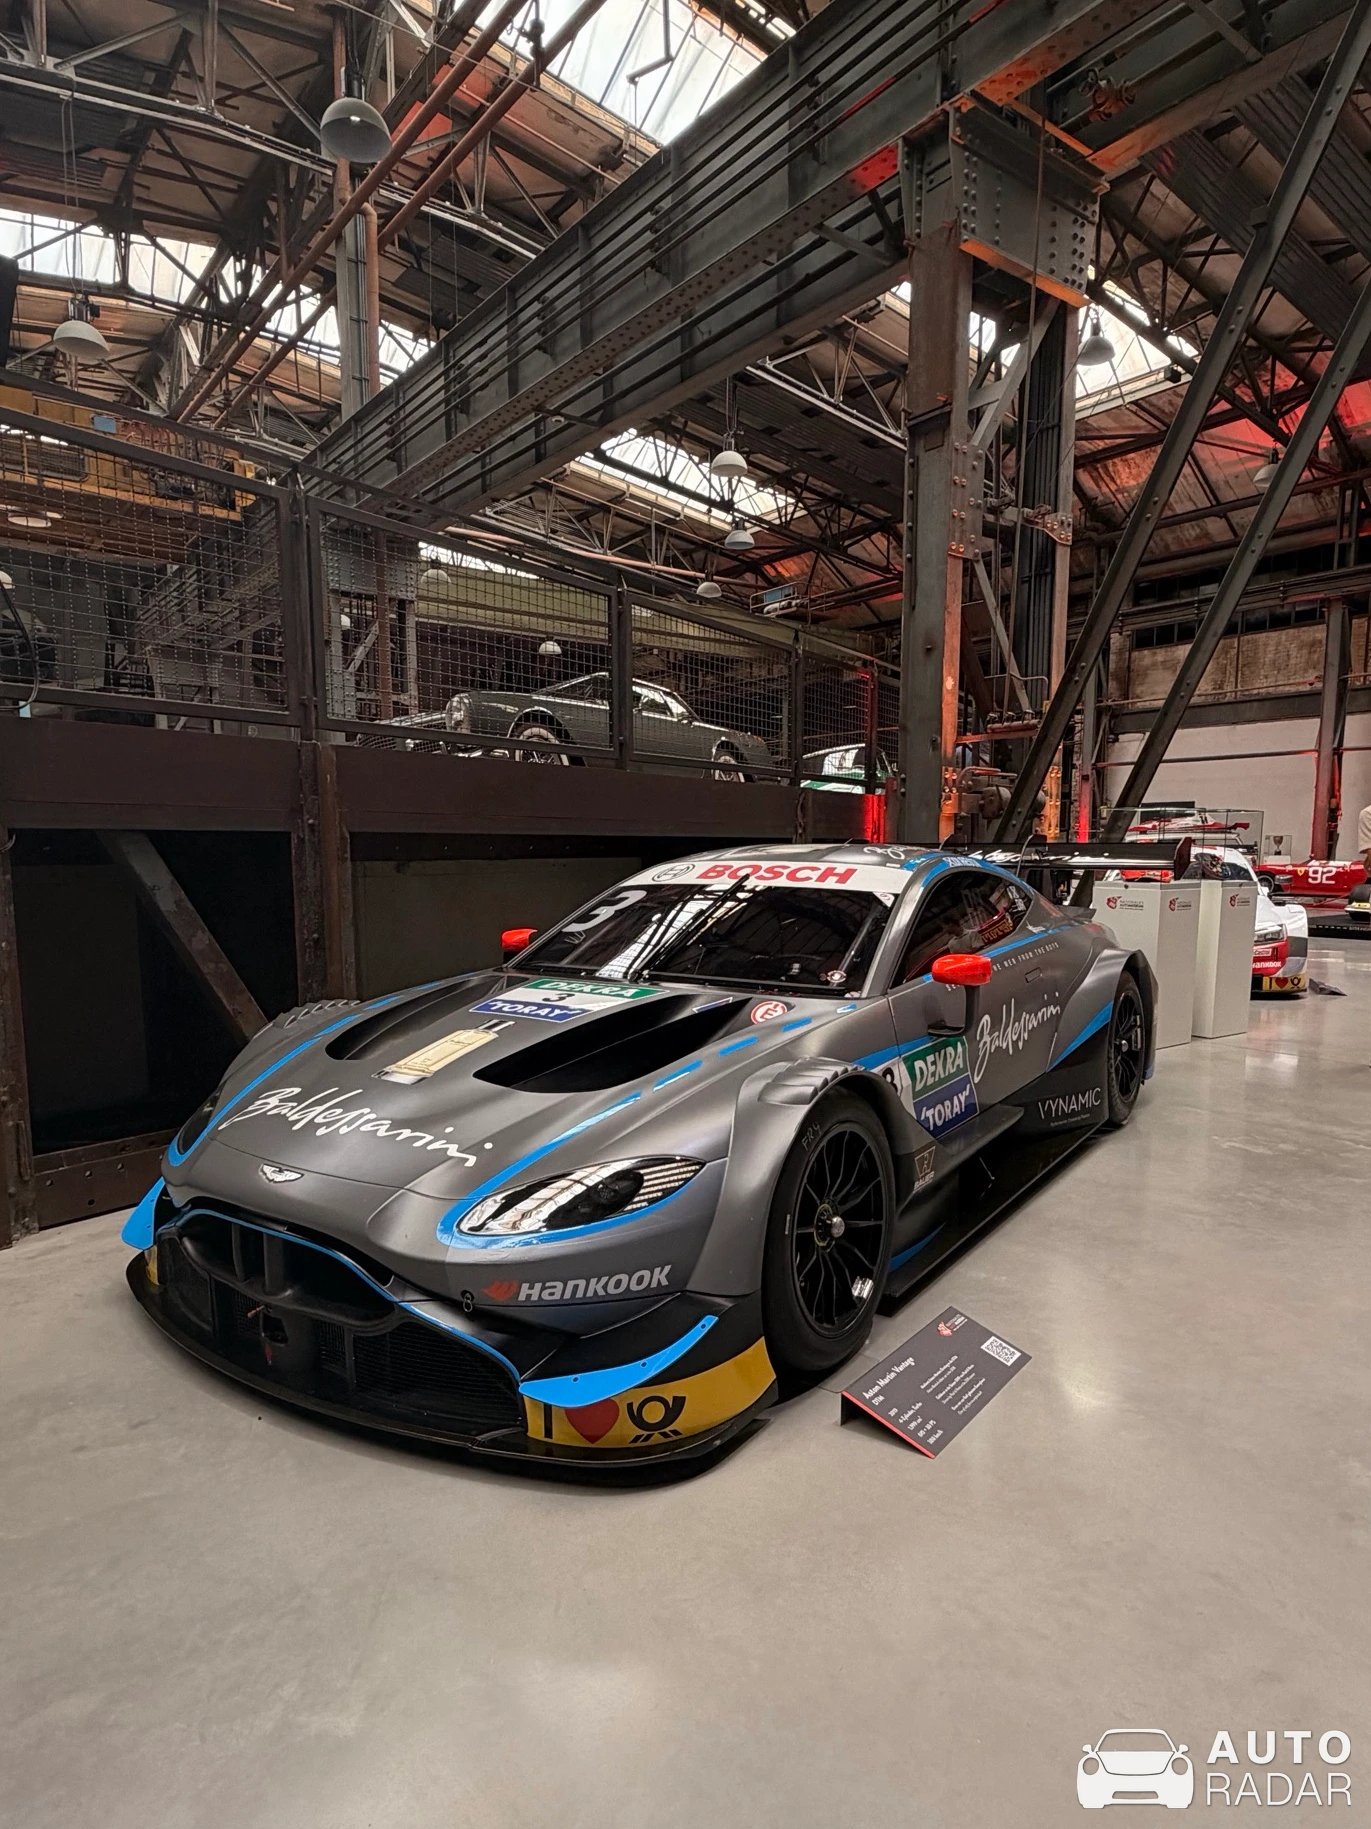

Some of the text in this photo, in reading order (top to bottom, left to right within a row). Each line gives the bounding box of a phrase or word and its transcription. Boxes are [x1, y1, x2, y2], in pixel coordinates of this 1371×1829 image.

[696, 864, 858, 885] BOSCH
[1308, 866, 1337, 884] 92
[561, 889, 648, 933] 3
[538, 980, 641, 998] DEKRA
[542, 993, 575, 1003] 3
[974, 991, 1061, 1083] Baldessarini
[913, 1041, 964, 1092] DEKRA
[1038, 1087, 1101, 1119] VYNAMIC
[219, 1087, 493, 1167] Baldessarini
[862, 1384, 880, 1399] Aston
[876, 1370, 896, 1387] Martin
[891, 1357, 916, 1376] Vantage
